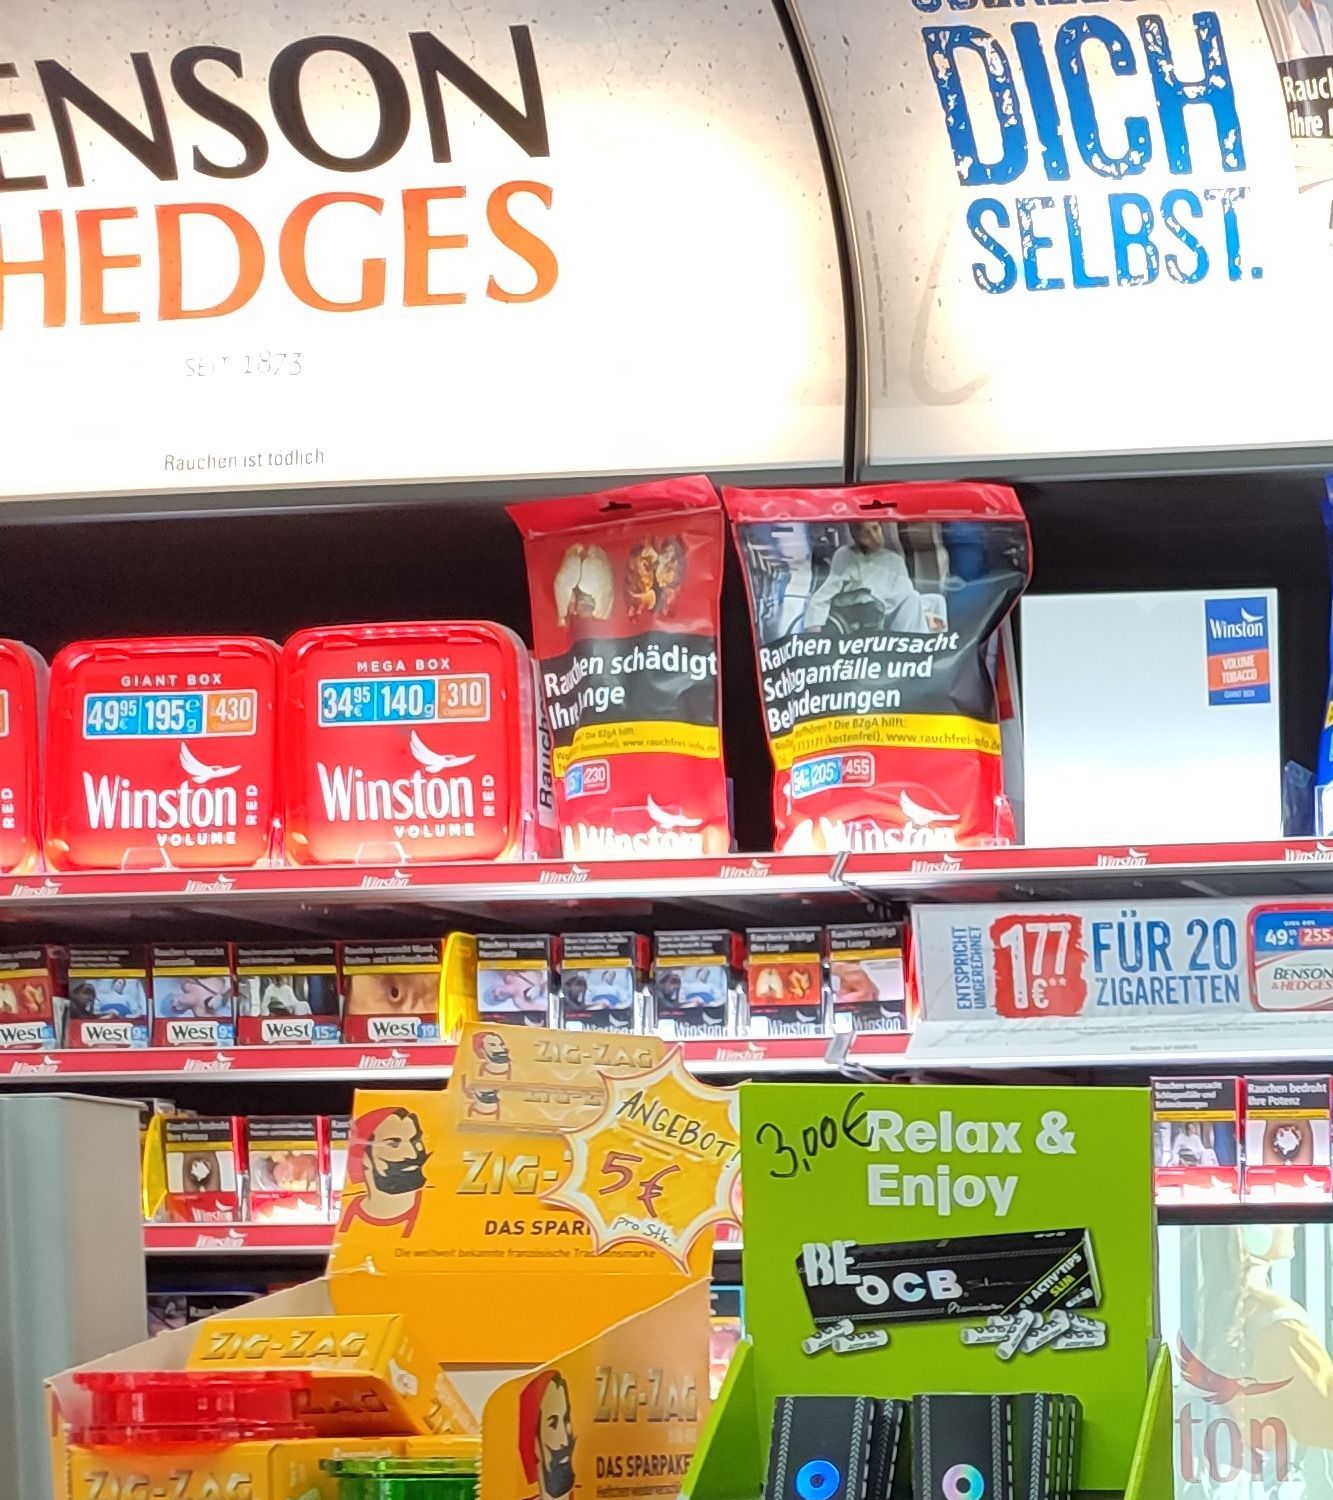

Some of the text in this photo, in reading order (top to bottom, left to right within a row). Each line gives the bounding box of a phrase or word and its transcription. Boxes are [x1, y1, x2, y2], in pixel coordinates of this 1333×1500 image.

[921, 11, 1246, 186] DICH
[1289, 110, 1324, 137] Ihre
[966, 187, 1264, 294] SELBST.
[164, 456, 238, 472] Rauchen
[1209, 617, 1264, 639] Winston
[839, 631, 960, 654] verursacht
[357, 658, 451, 673] MEGA BOX
[610, 645, 718, 680] schädigt
[888, 656, 933, 679] und
[120, 673, 222, 688] GIANT BOX
[83, 772, 236, 830] Winston
[317, 762, 473, 821] Winston
[157, 832, 236, 846] VOLUME
[394, 824, 475, 837] VOLUME
[1093, 910, 1237, 974] FÜR 20
[958, 926, 970, 1010] ENTSPRICHT
[974, 926, 984, 1010] UMGERECHNET
[1095, 975, 1240, 1007] ZIGARETTEN
[1283, 978, 1333, 991] HEDGES
[1, 1026, 44, 1042] West
[85, 1026, 129, 1041] West
[172, 1024, 214, 1041] West
[266, 1021, 310, 1038] West
[372, 1020, 417, 1037] West
[533, 1040, 654, 1068] ZIG-ZAG
[867, 1111, 1076, 1154] Relax &
[867, 1164, 1018, 1217] Enjoy
[485, 1220, 524, 1235] DAS
[856, 1269, 963, 1305] OCB
[201, 1331, 368, 1360] ZIG-ZAG
[594, 1366, 696, 1423] ZIG-ZAG
[596, 1455, 622, 1478] DAS
